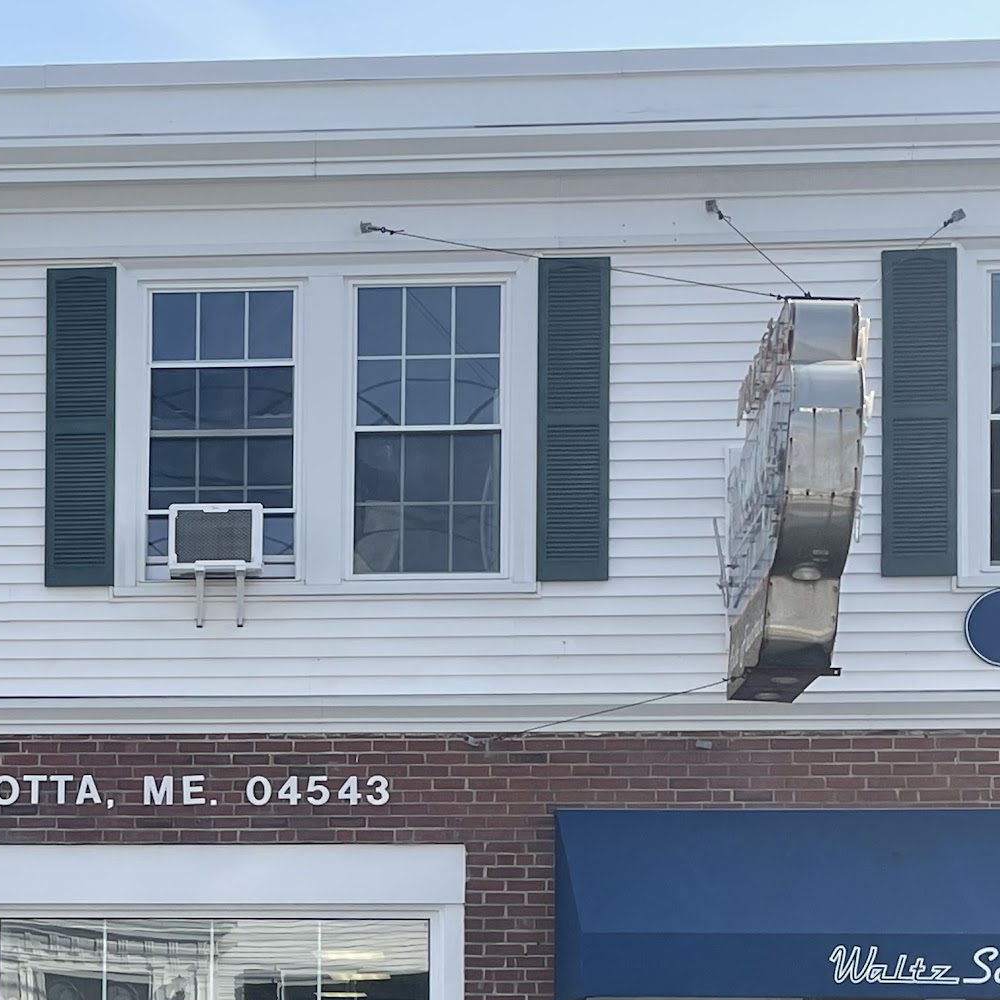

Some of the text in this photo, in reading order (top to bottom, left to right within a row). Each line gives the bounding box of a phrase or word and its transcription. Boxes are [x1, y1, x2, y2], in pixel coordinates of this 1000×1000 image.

[143, 775, 217, 806] ME.
[246, 775, 390, 806] 04543
[829, 945, 960, 985] Waltz
